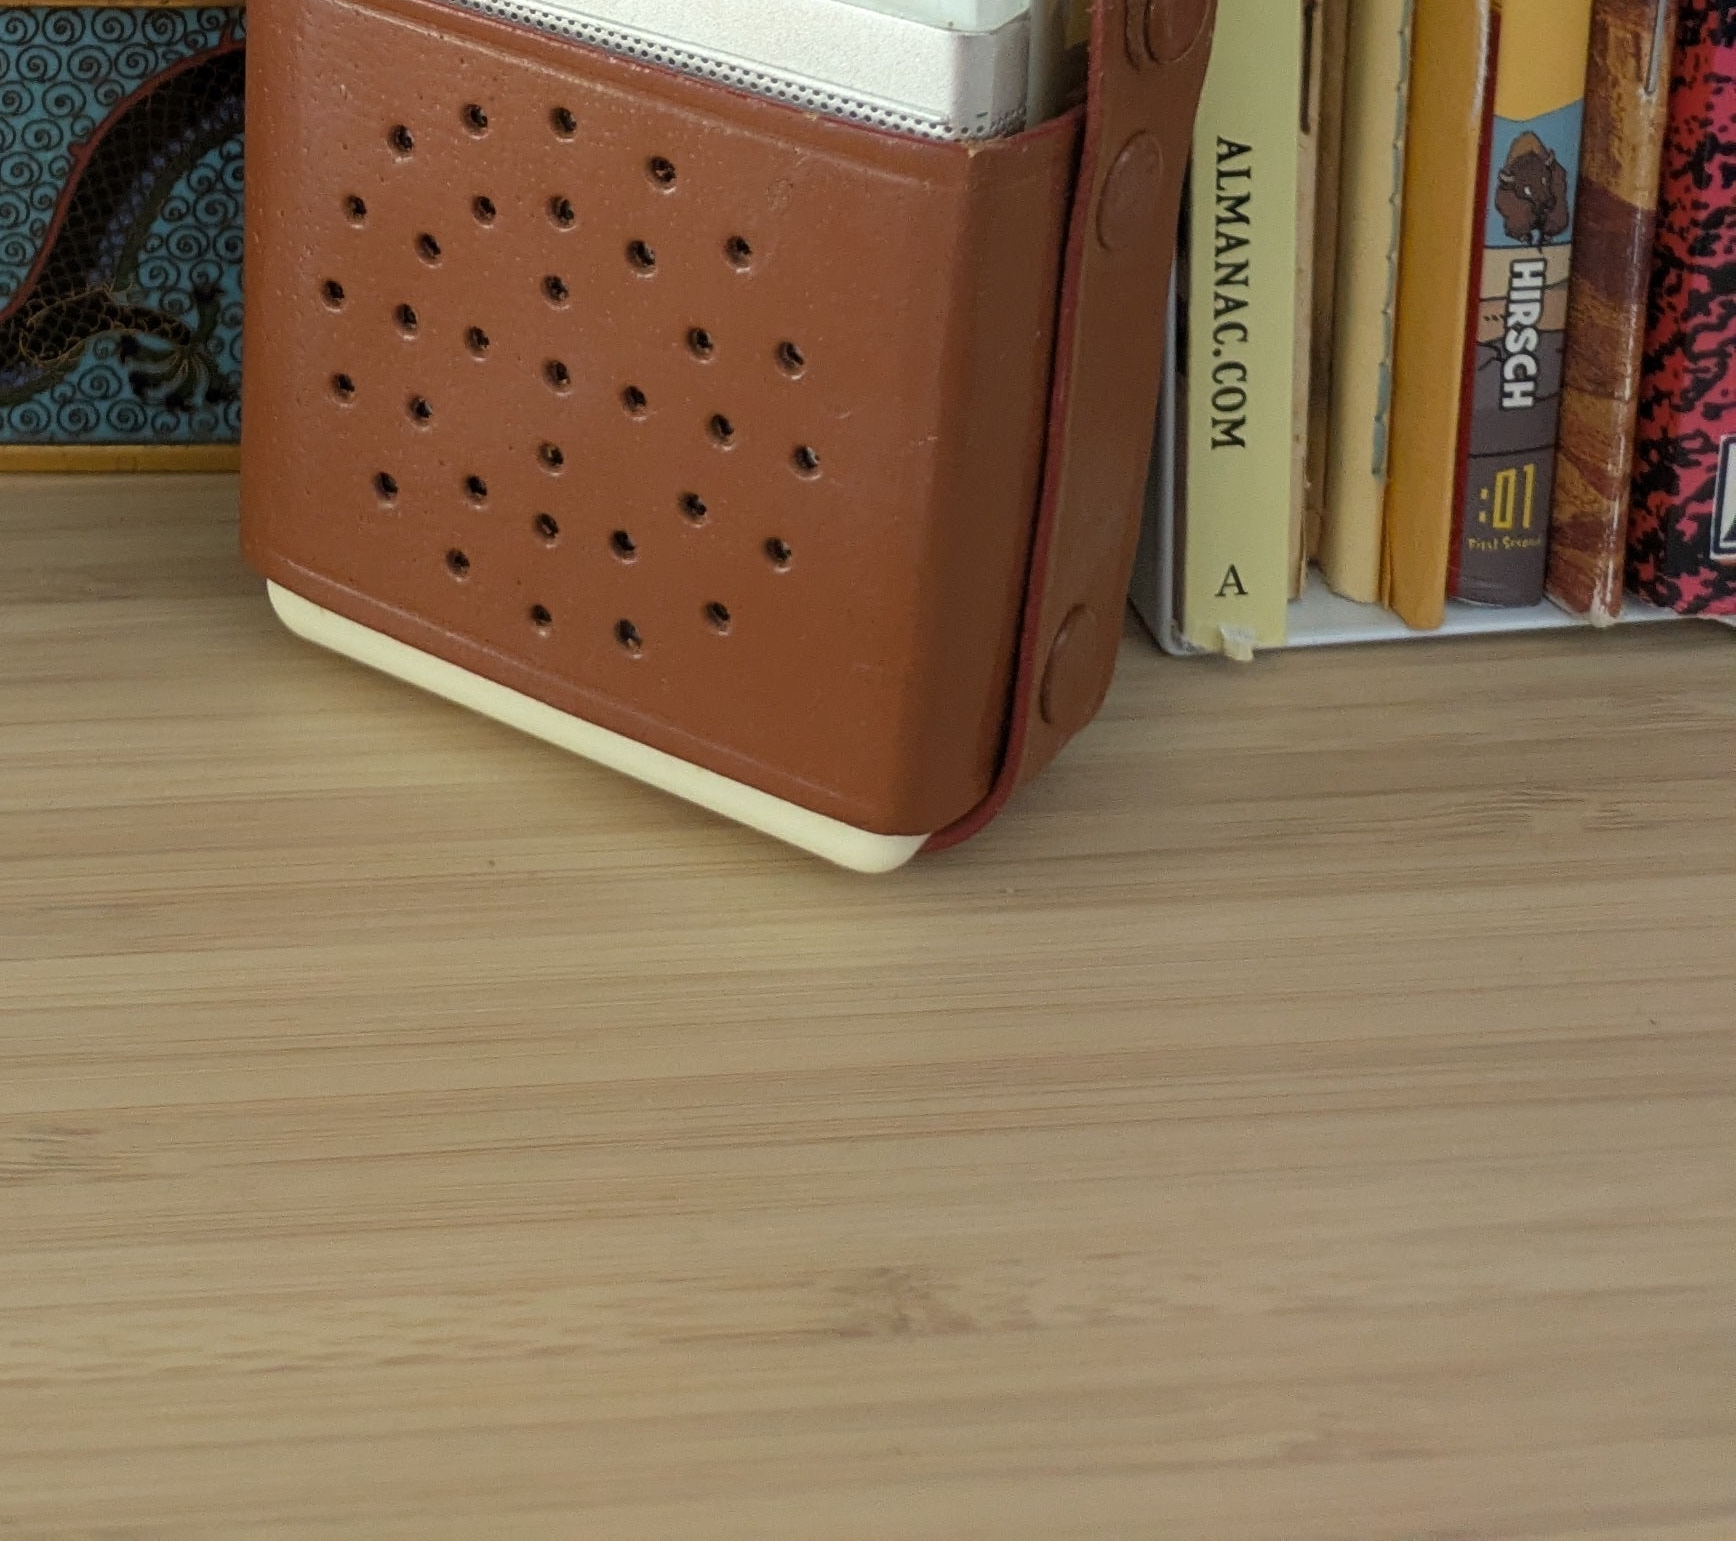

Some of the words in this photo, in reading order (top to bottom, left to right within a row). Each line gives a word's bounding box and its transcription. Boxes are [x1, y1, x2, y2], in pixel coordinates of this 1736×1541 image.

[1211, 135, 1255, 452] ALMANAC.COM
[1500, 258, 1548, 411] HIRSCH
[1215, 565, 1248, 597] A
